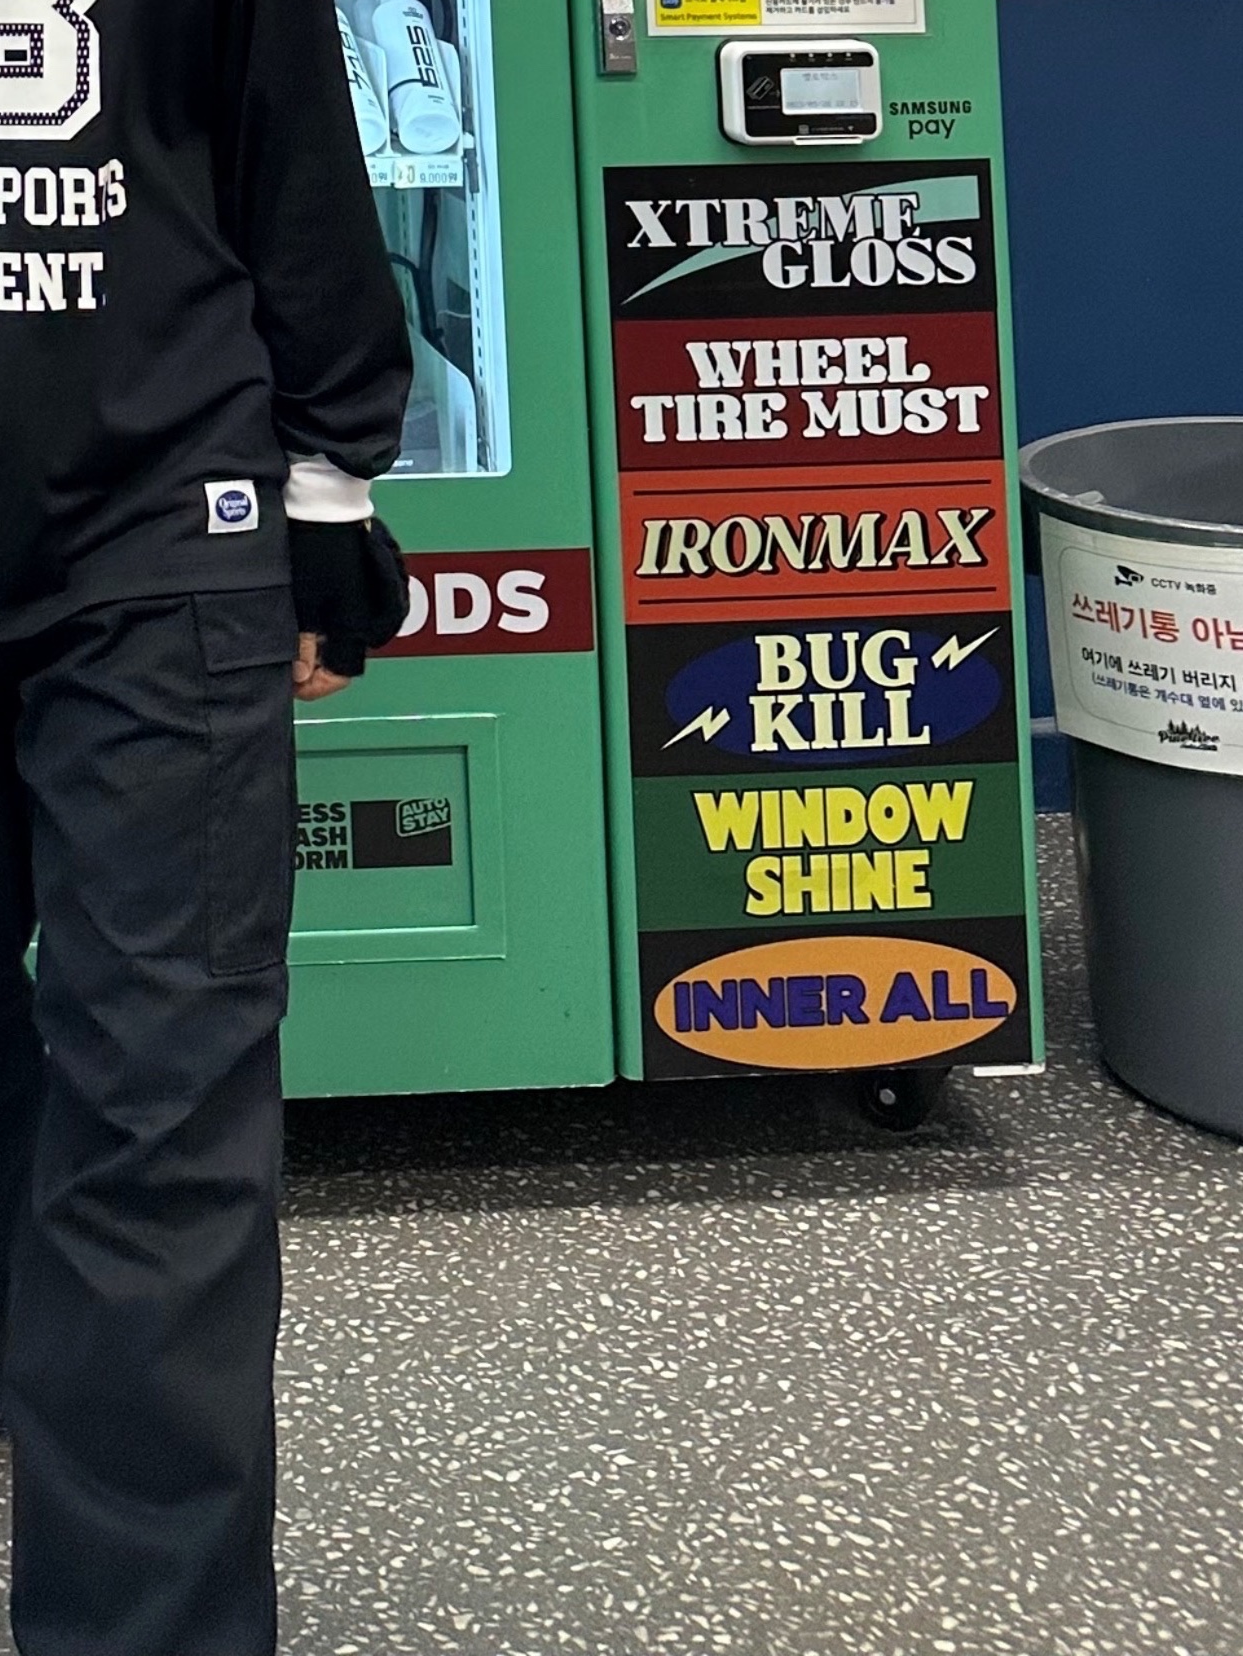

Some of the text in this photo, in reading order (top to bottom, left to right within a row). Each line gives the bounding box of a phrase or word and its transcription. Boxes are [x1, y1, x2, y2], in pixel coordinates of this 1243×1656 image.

[889, 101, 972, 116] SAMSUNG
[908, 117, 957, 140] pay
[625, 194, 920, 248] XTREME
[762, 236, 977, 289] GLOSS
[685, 336, 931, 389] WHEEL
[630, 386, 989, 443] TIRE MUST
[635, 507, 996, 577] IRONMAX
[1151, 578, 1181, 590] CCTV
[1072, 593, 1180, 643] 쓰레기통
[754, 629, 919, 691] BUG
[1082, 647, 1237, 692] 여기에 쓰레기 버리지
[748, 690, 930, 752] KILL
[402, 798, 447, 816] AUTO
[402, 808, 451, 832] STAY
[693, 781, 974, 851] WINDOW
[744, 849, 932, 915] SHINE
[674, 969, 1010, 1032] INNER ALL
